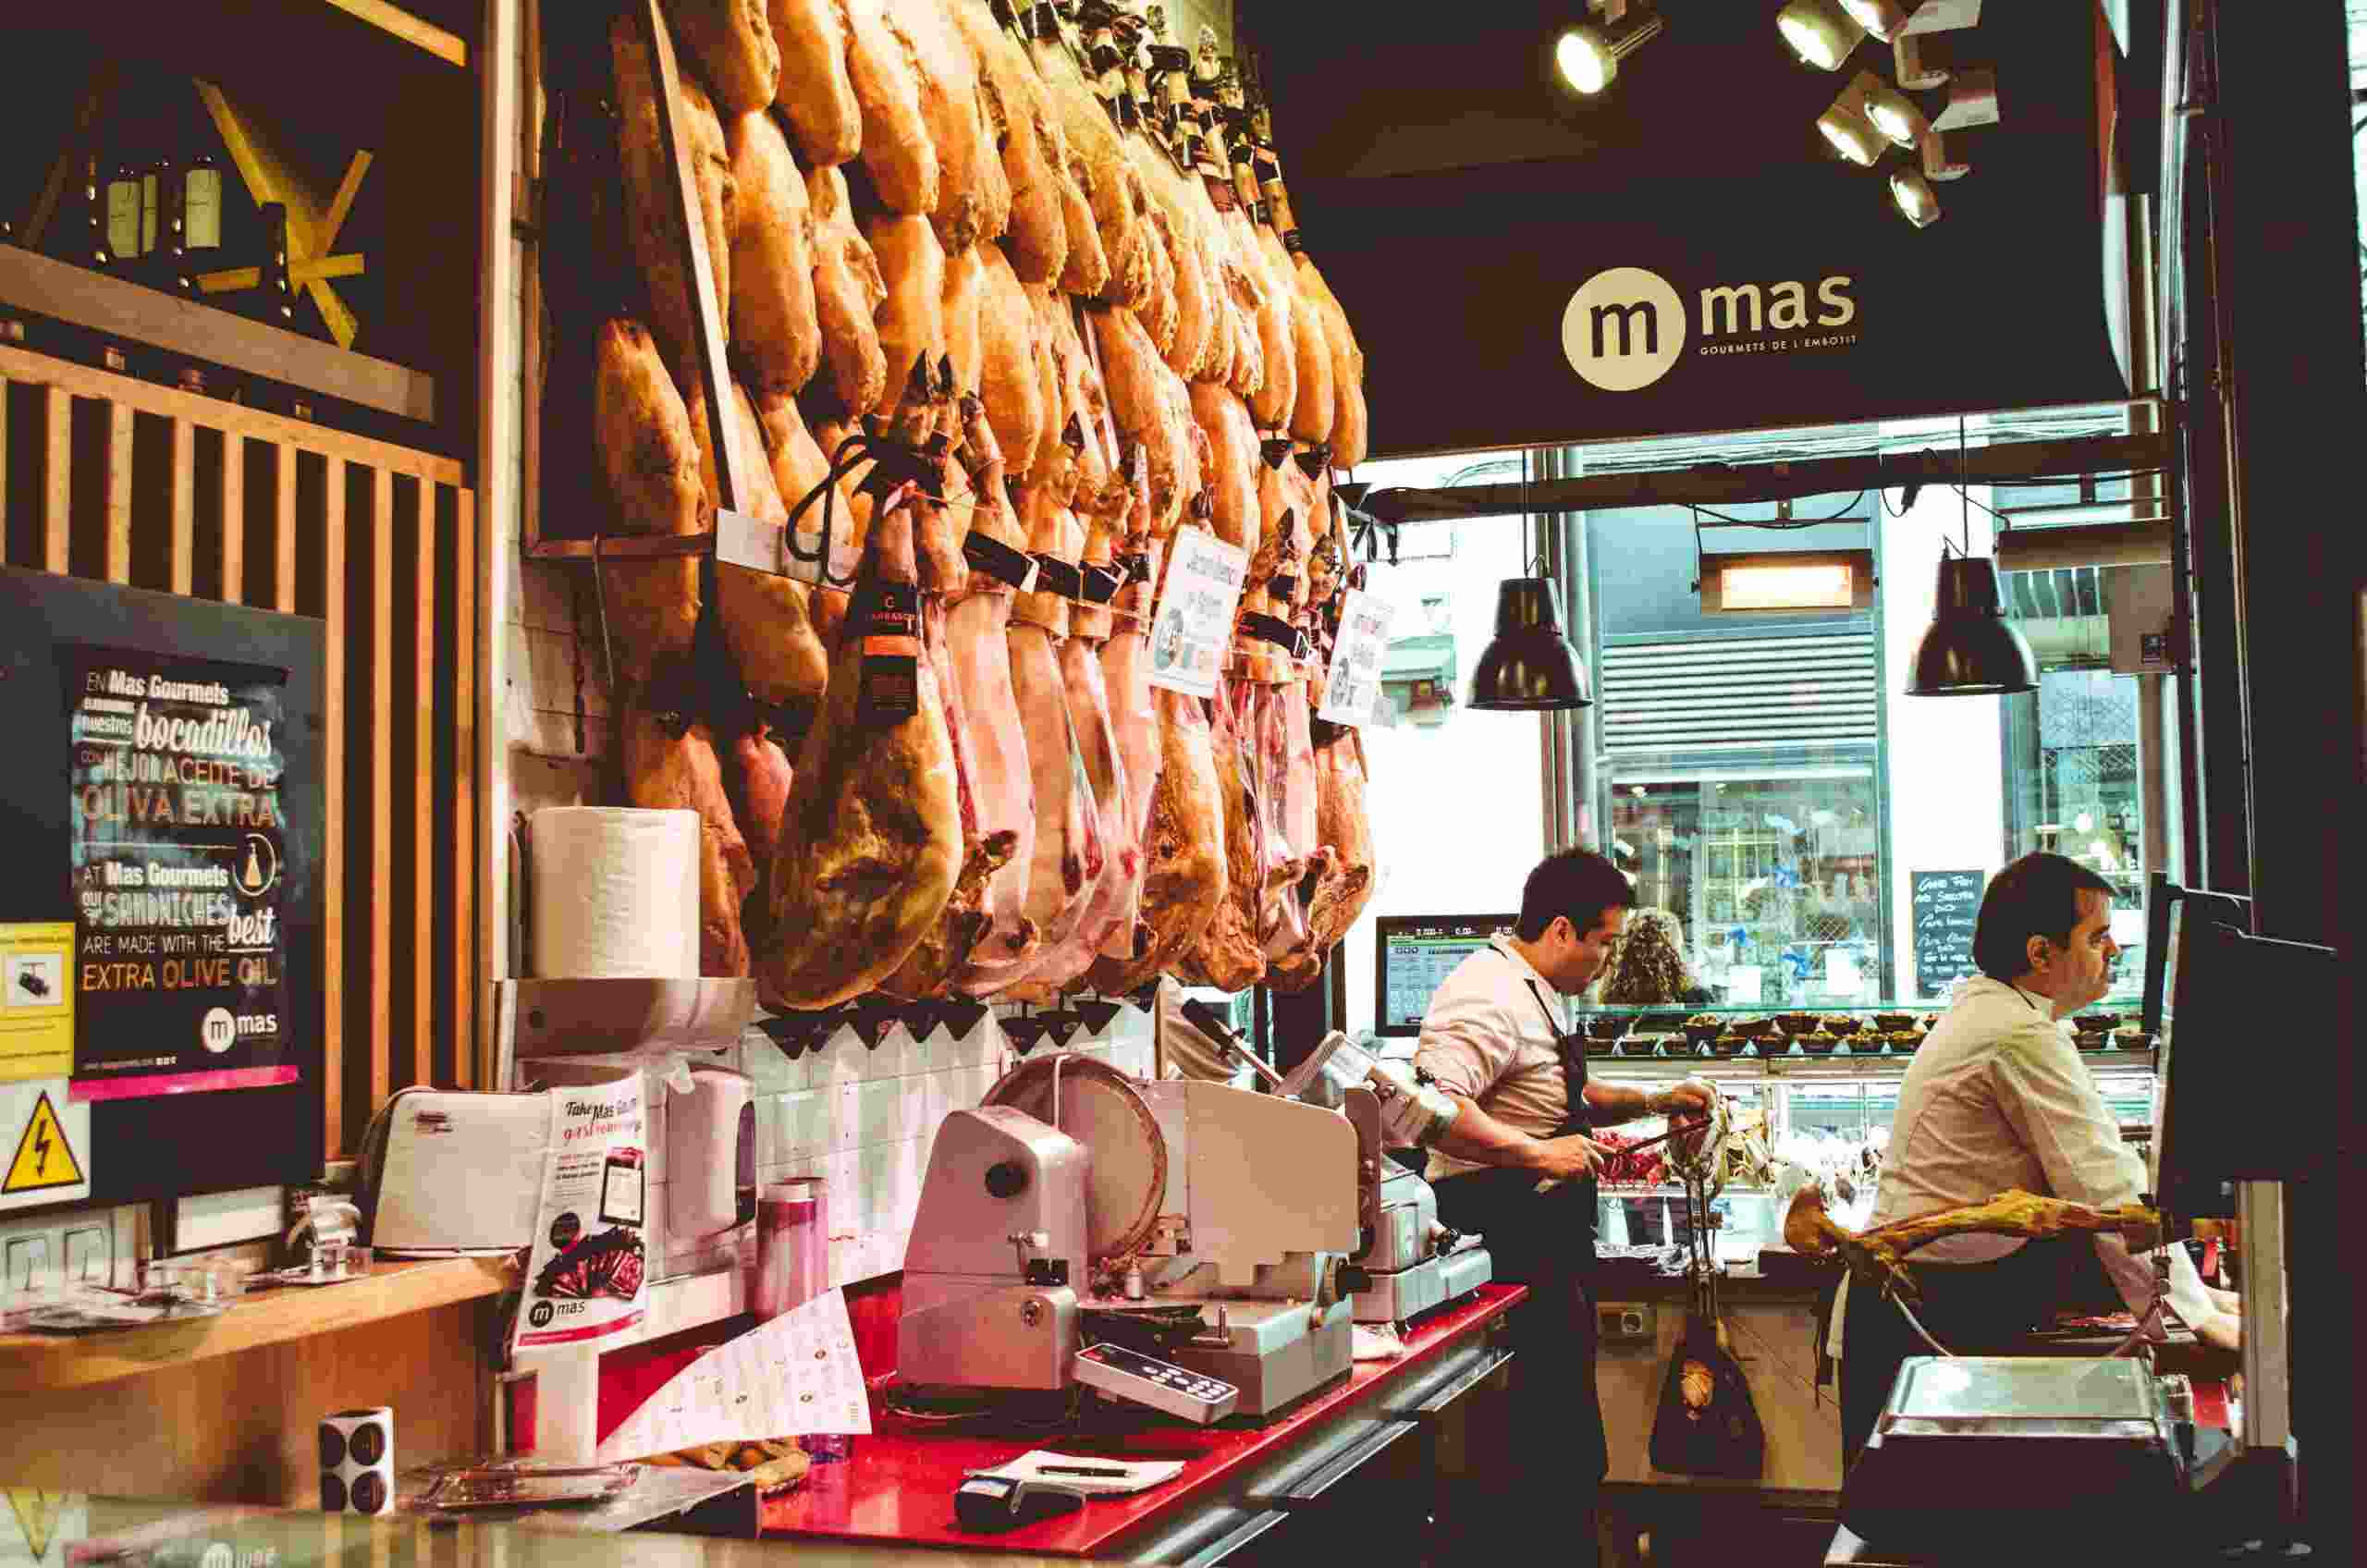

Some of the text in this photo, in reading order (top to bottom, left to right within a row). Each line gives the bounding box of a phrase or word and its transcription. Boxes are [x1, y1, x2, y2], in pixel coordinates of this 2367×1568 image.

[1699, 276, 1856, 336] mas
[1589, 300, 1659, 358] m
[1700, 340, 1765, 356] GOURMETS
[1772, 340, 1787, 351] DE
[85, 671, 106, 692] EN
[107, 669, 146, 696] Mas
[149, 674, 230, 705] Gourmets
[135, 702, 272, 756] bocadillos
[163, 756, 240, 788] ACEITE
[81, 784, 276, 828] OLIVA EXTRA
[83, 860, 229, 888] AT Mas Gourmets
[227, 906, 276, 946] best
[81, 936, 112, 955] ARE
[117, 934, 156, 954] MADE
[161, 934, 196, 953] WITH
[201, 934, 228, 953] THE
[81, 957, 277, 991] EXTRA OLIVE OIL
[236, 1013, 278, 1035] mas
[557, 1301, 585, 1316] mas
